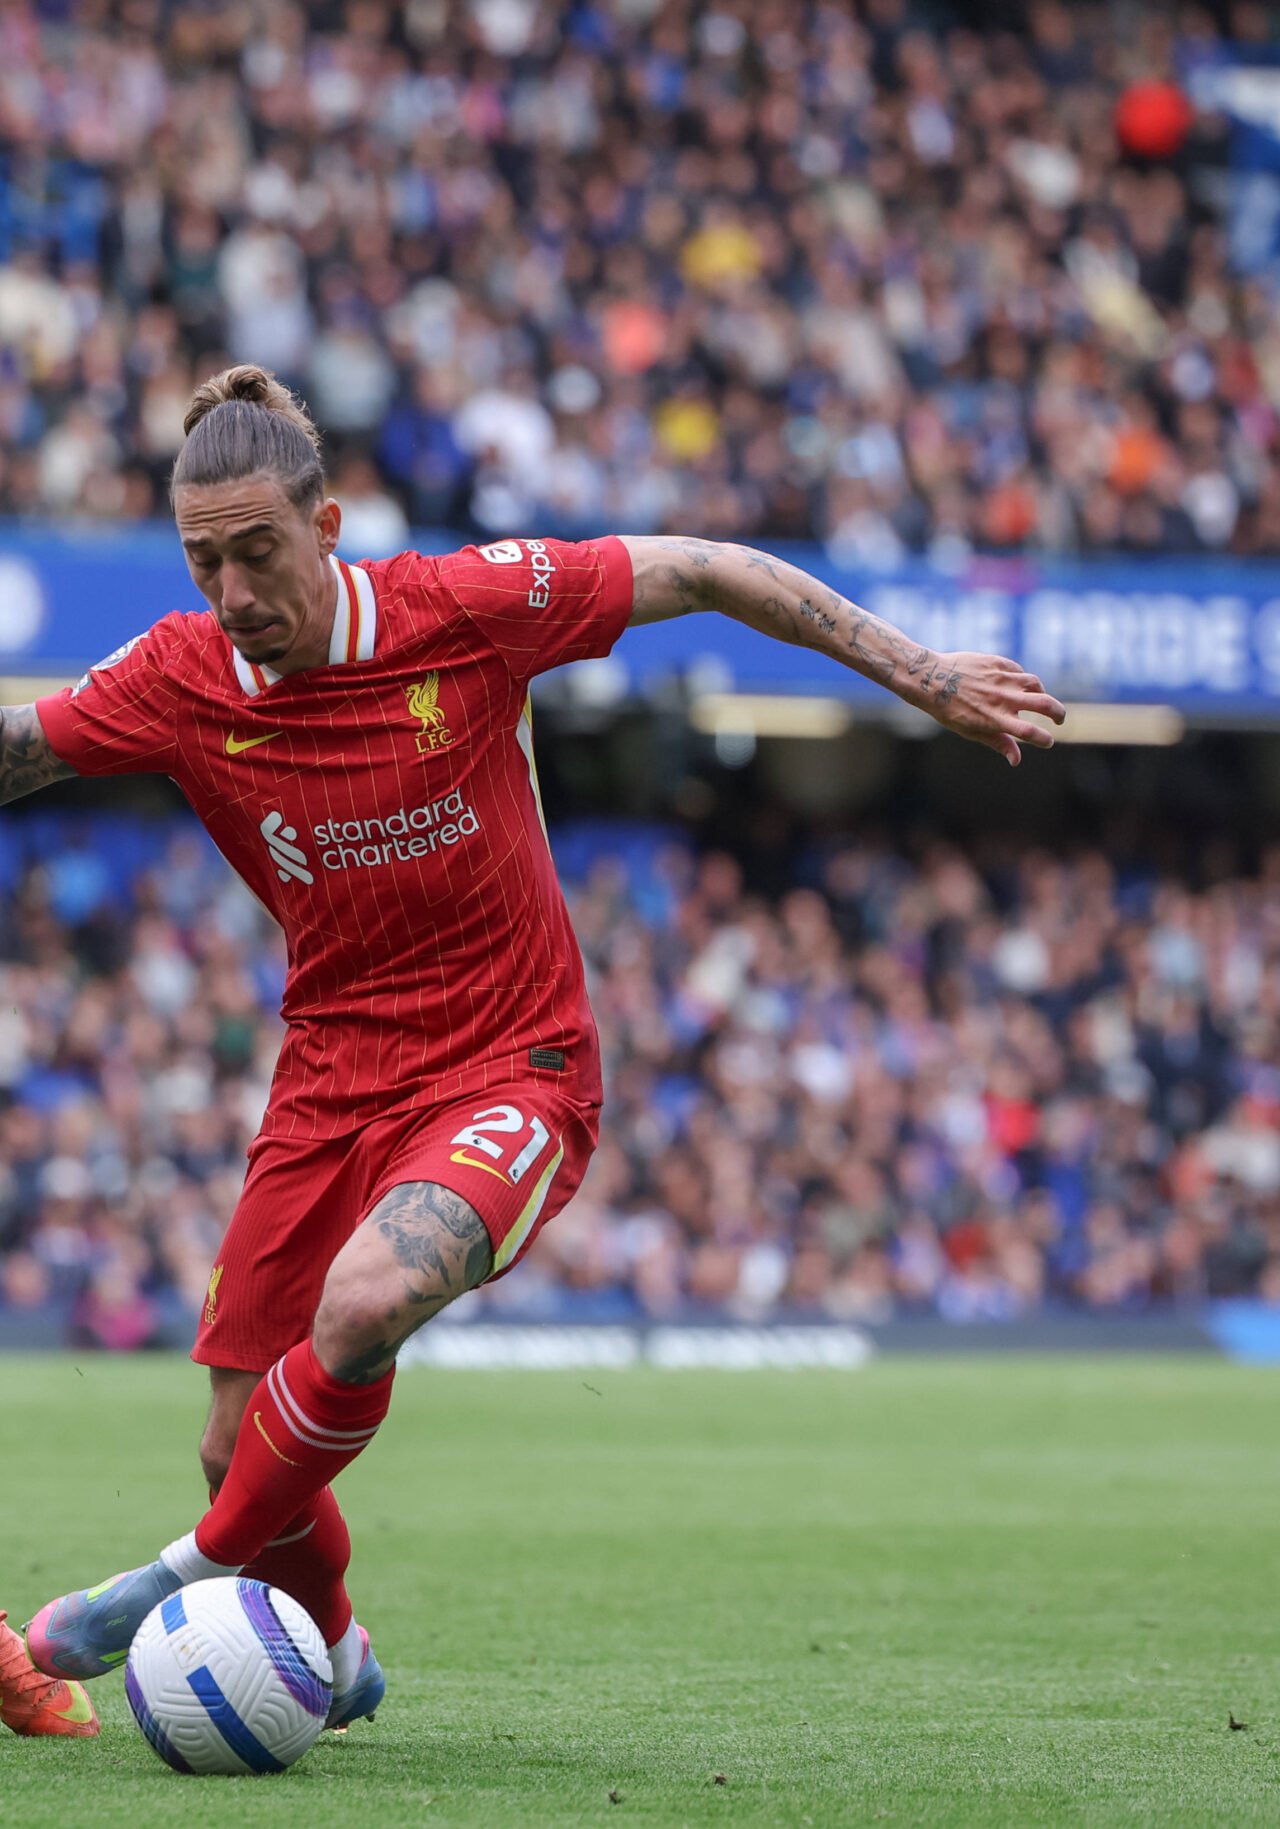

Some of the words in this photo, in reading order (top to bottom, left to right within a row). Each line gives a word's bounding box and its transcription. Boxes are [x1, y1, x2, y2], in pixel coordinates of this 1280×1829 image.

[527, 539, 556, 609] Expe
[313, 786, 465, 846] standard
[322, 805, 480, 870] chartered
[450, 1104, 551, 1184] 21
